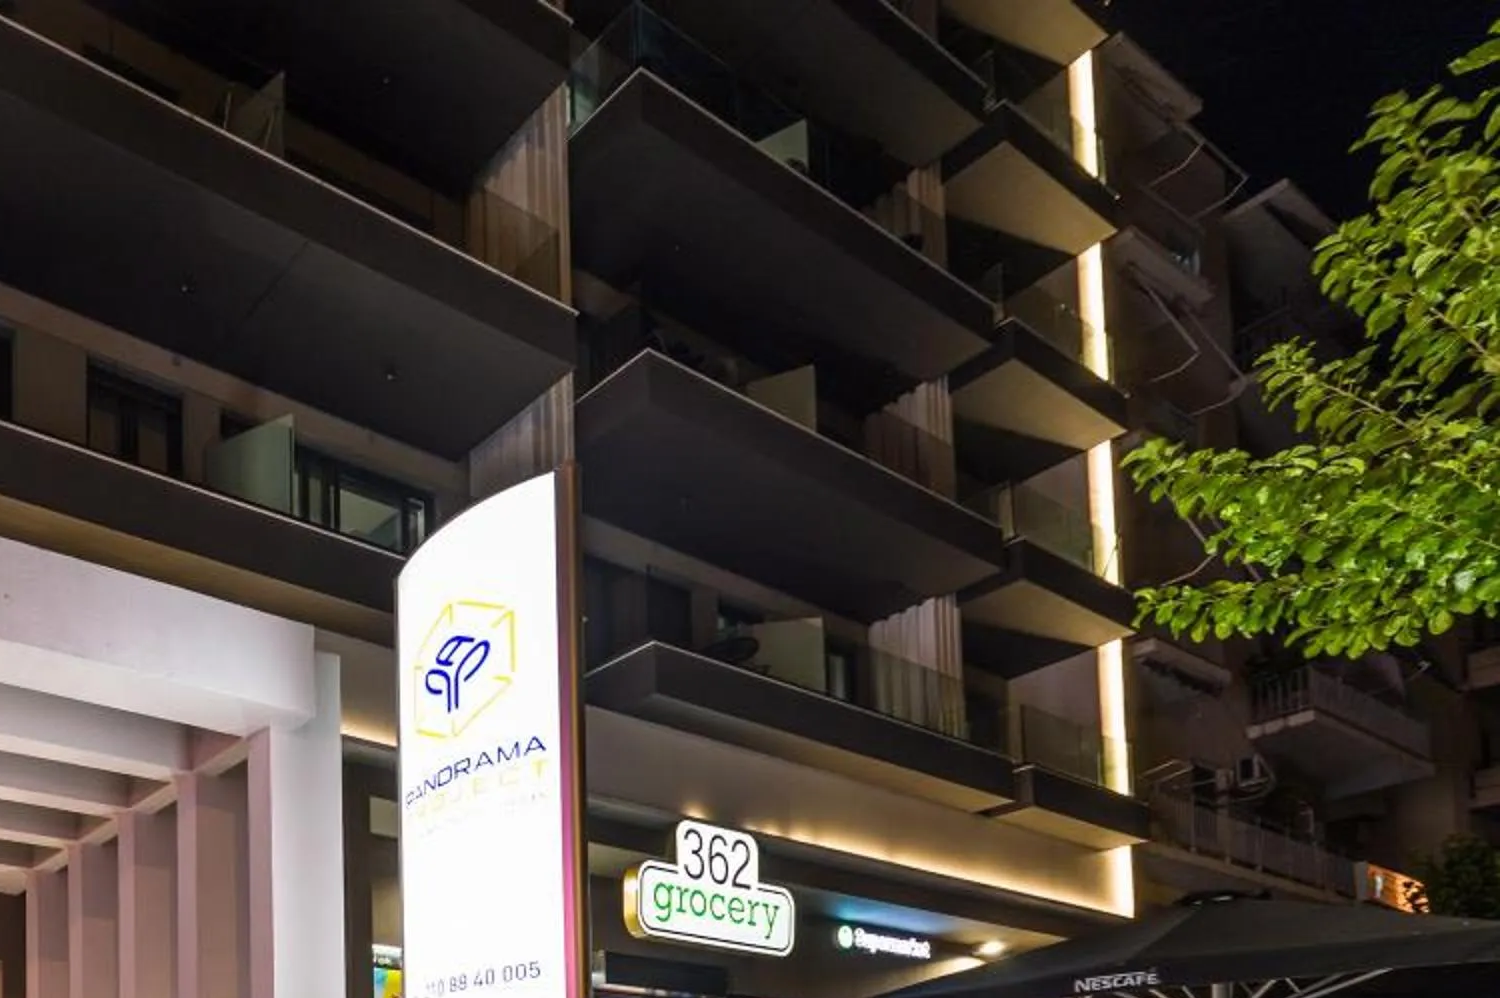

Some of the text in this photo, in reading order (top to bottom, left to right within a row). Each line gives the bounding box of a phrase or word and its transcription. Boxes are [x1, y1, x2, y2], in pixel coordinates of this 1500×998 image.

[405, 735, 547, 810] PANORAMA
[683, 828, 751, 891] 362
[653, 882, 780, 940] grocery
[473, 968, 496, 988] 40
[503, 960, 542, 983] 005
